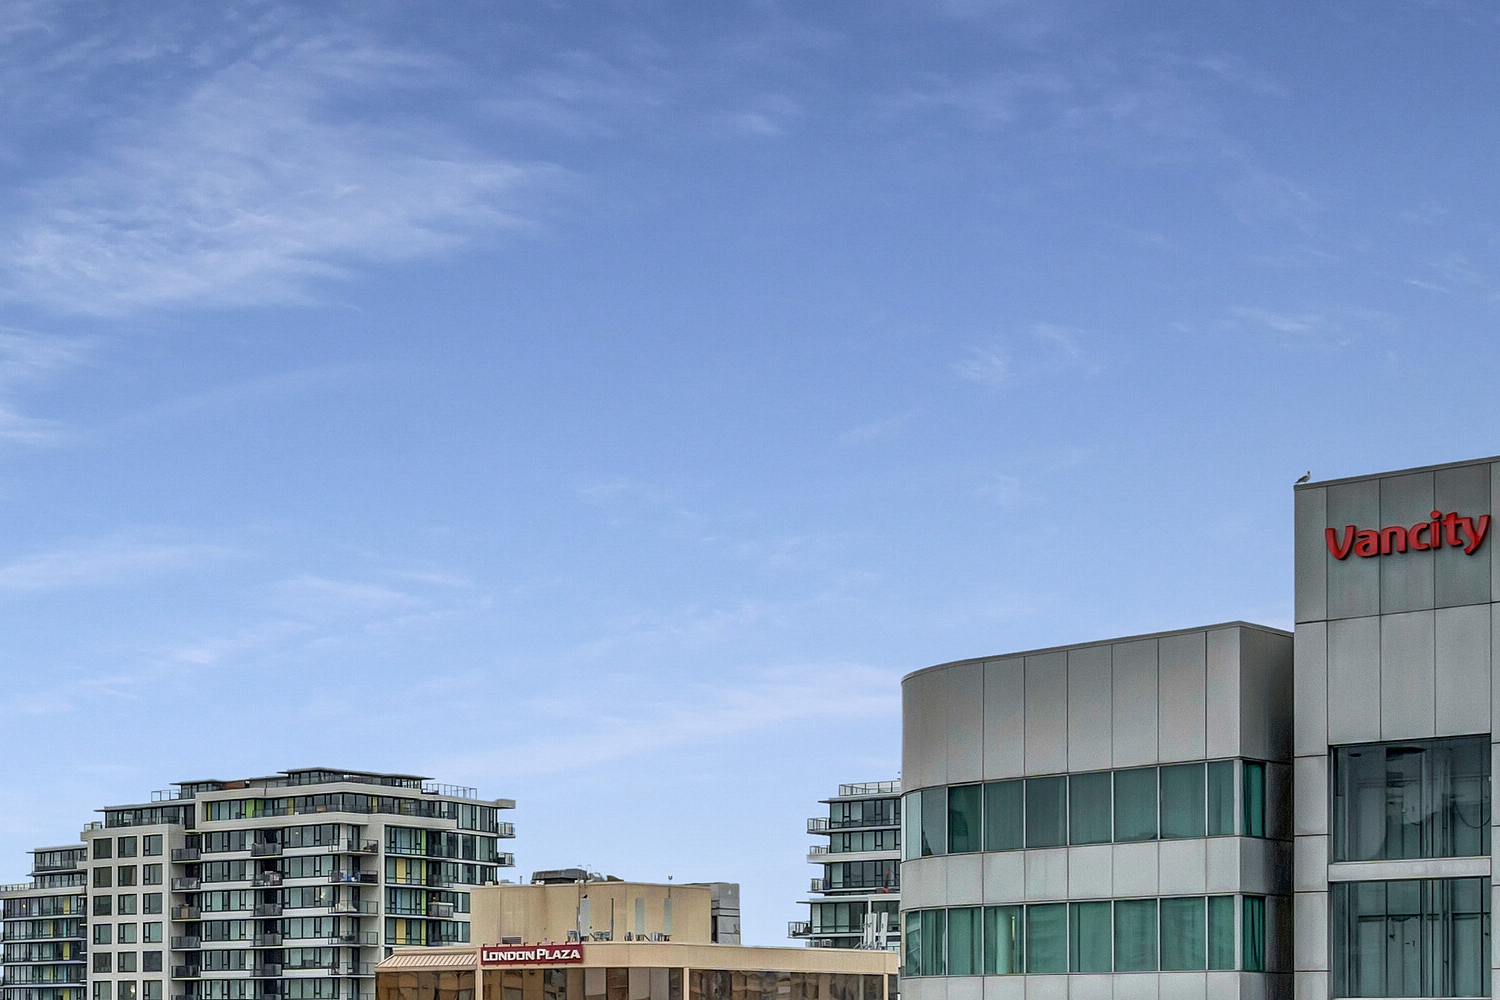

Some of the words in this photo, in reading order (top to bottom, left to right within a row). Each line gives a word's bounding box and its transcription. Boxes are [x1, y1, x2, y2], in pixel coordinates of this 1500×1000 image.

[1325, 510, 1491, 560] Vancity
[482, 950, 535, 962] LONDON
[536, 948, 581, 960] PLAZA
